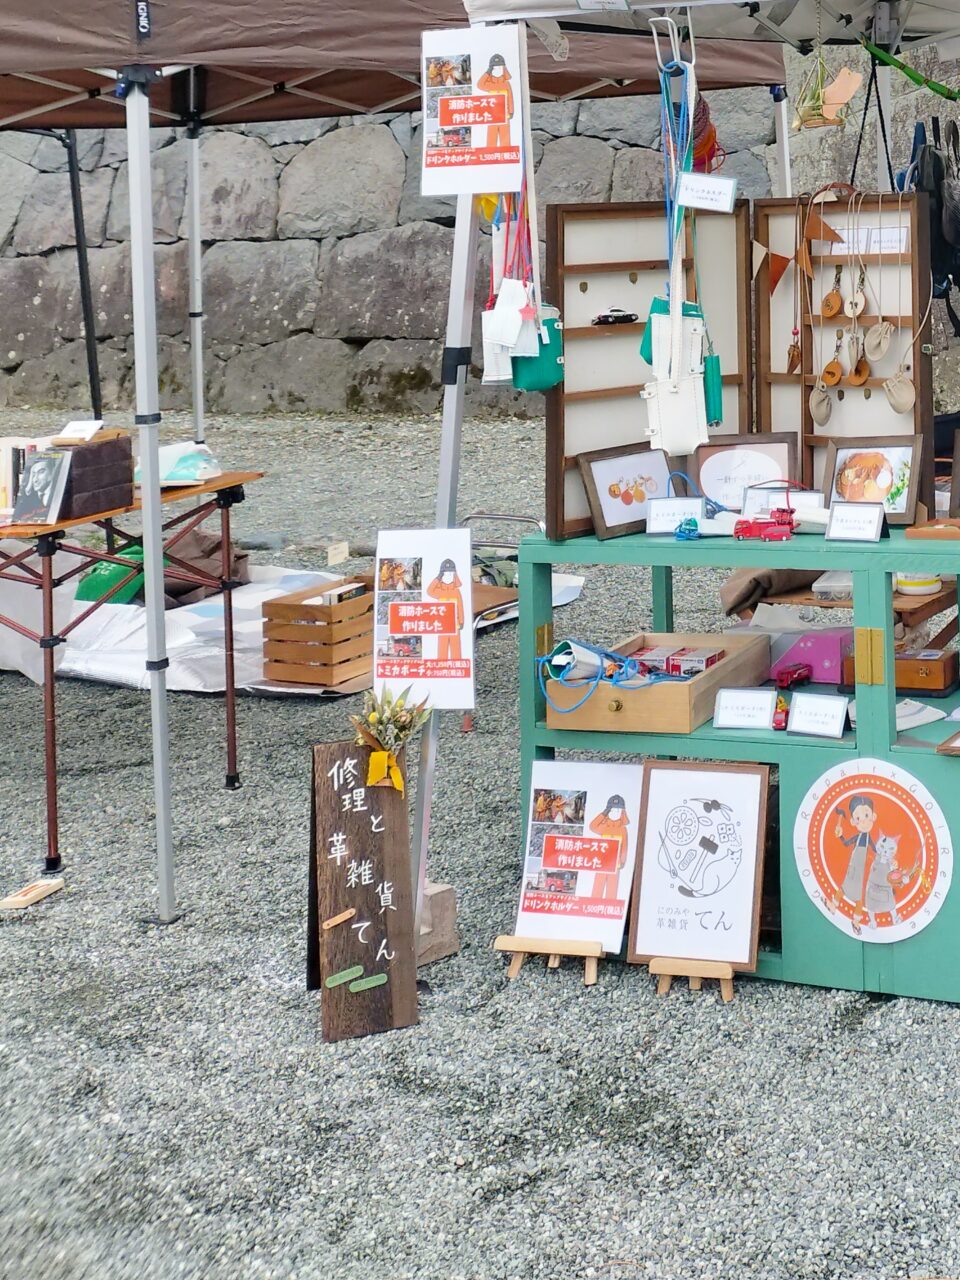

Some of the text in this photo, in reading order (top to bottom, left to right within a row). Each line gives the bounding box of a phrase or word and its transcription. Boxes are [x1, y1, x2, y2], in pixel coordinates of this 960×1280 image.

[137, 1, 150, 33] IGNIO
[448, 98, 496, 110] 消防ホースで
[452, 111, 493, 124] 作りました
[426, 153, 477, 165] ドリンクホルダー
[398, 605, 446, 617] 消防ホースで
[402, 620, 443, 632] 作りました
[377, 664, 425, 677] トミカポーチ
[555, 838, 609, 853] 消防ホースで
[558, 854, 602, 869] 作りました
[524, 899, 580, 912] ドリンクホルダー
[657, 906, 733, 931] にのみや てん
[657, 917, 689, 931] 革雑貨
